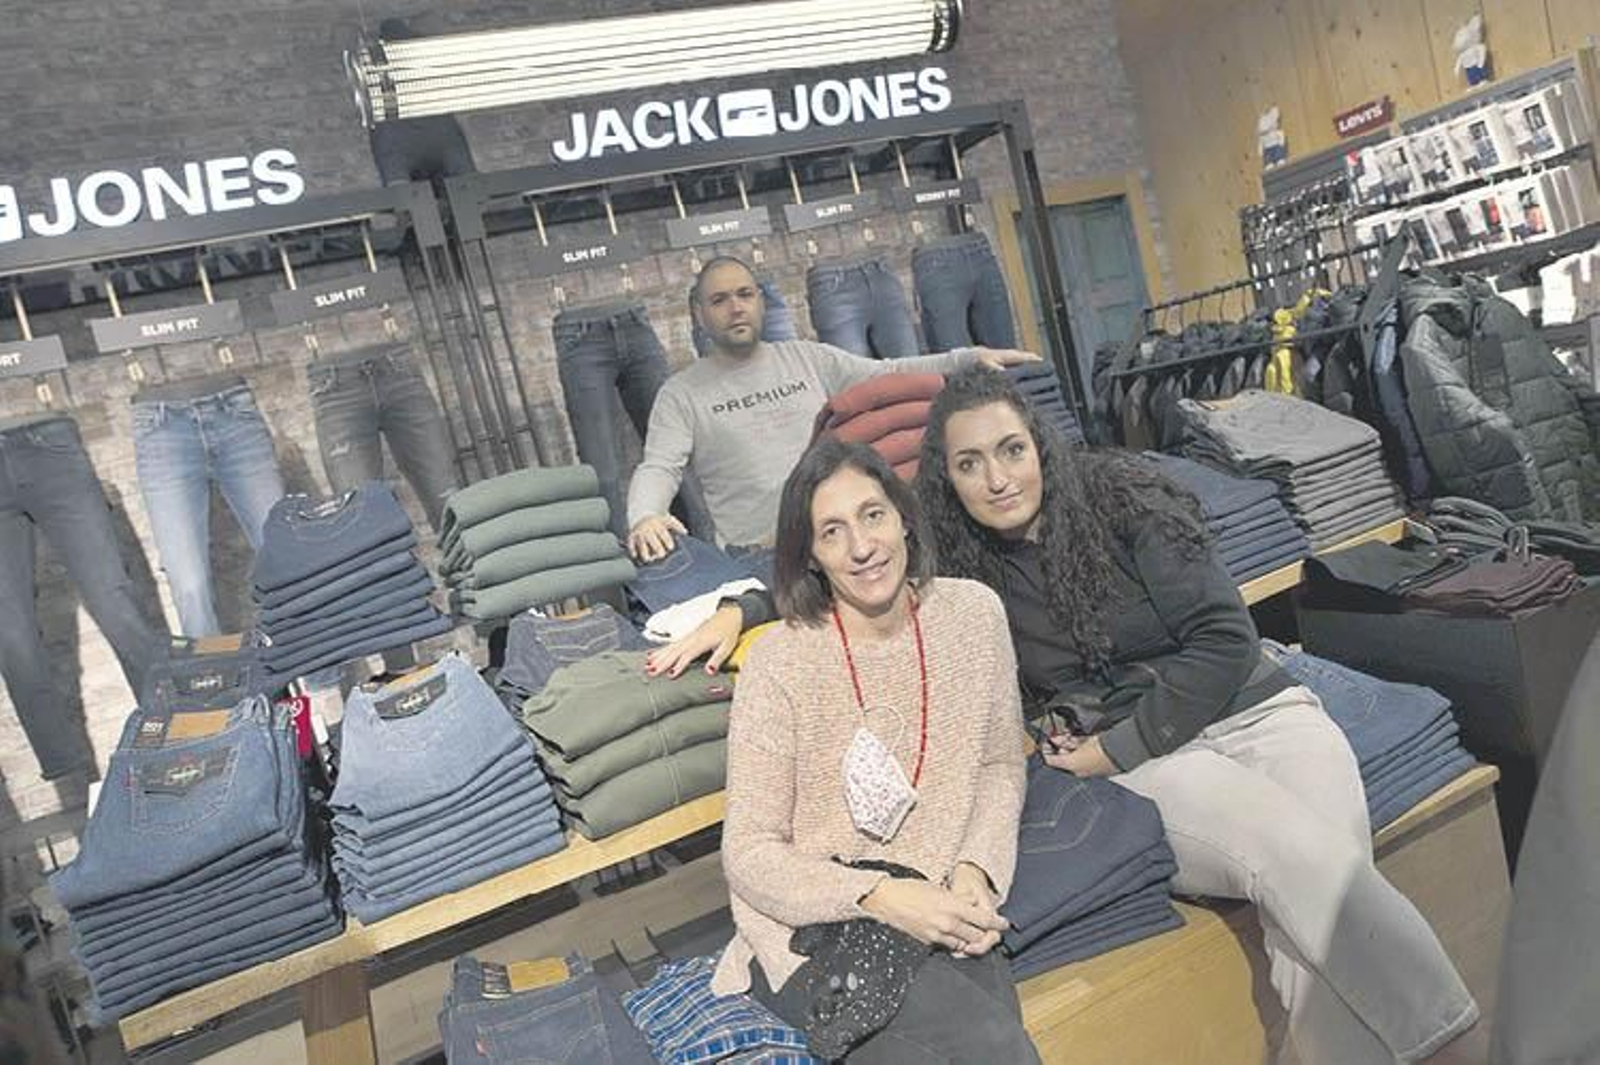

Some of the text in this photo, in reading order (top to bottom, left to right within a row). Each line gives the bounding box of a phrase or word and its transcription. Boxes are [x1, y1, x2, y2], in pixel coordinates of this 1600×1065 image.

[551, 67, 952, 161] JACK JONES
[28, 149, 304, 237] JONES
[698, 220, 740, 236] SLIM FIT
[562, 246, 607, 263] SLIM FIT
[314, 286, 366, 307] SLIM FIT
[140, 317, 199, 338] SLIM FIT
[0, 352, 20, 367] RT
[711, 380, 809, 413] PREMIUM
